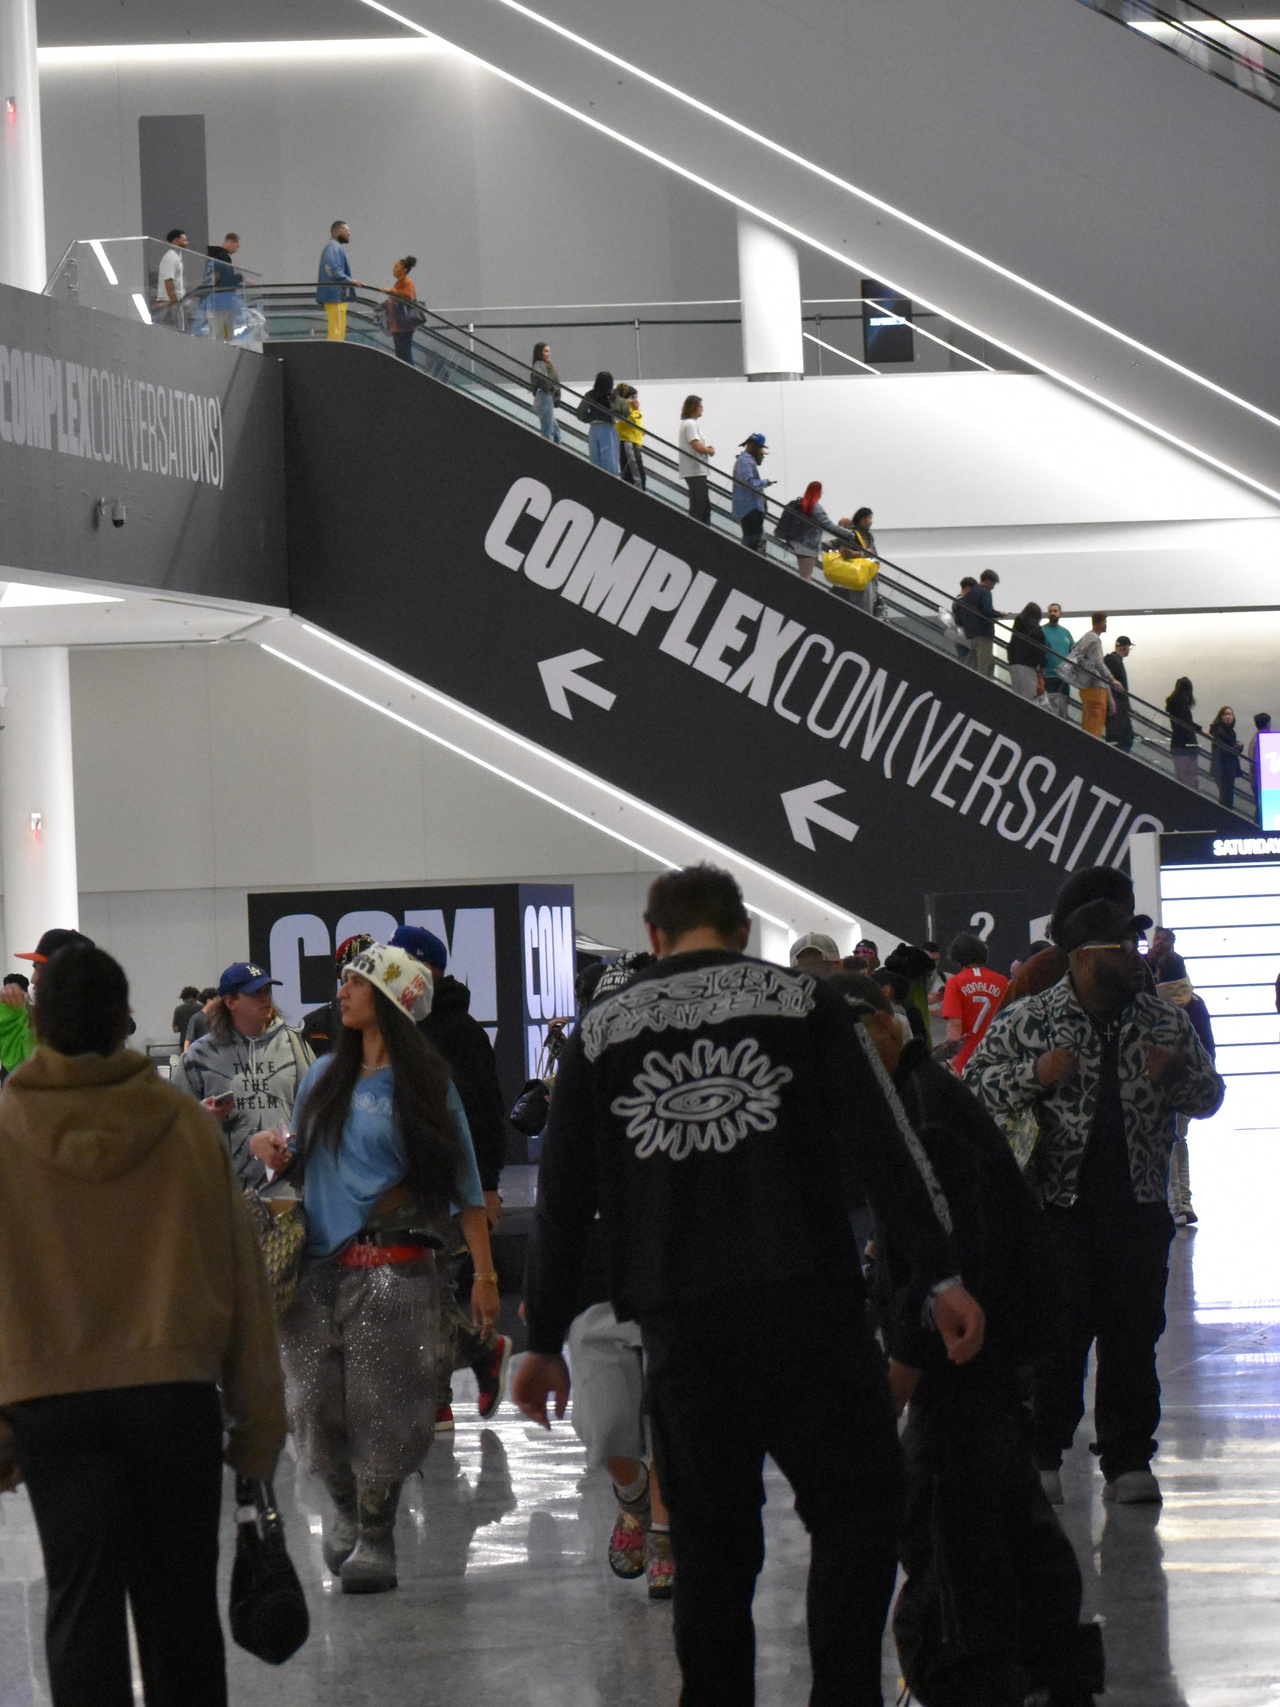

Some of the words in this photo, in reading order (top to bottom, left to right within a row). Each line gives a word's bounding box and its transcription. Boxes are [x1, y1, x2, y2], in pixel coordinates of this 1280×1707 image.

[524, 905, 576, 1019] COM
[960, 981, 1001, 997] RONALDO
[972, 995, 991, 1034] 7
[233, 1061, 276, 1075] TAKE
[242, 1079, 270, 1092] THE
[236, 1096, 279, 1110] HELM
